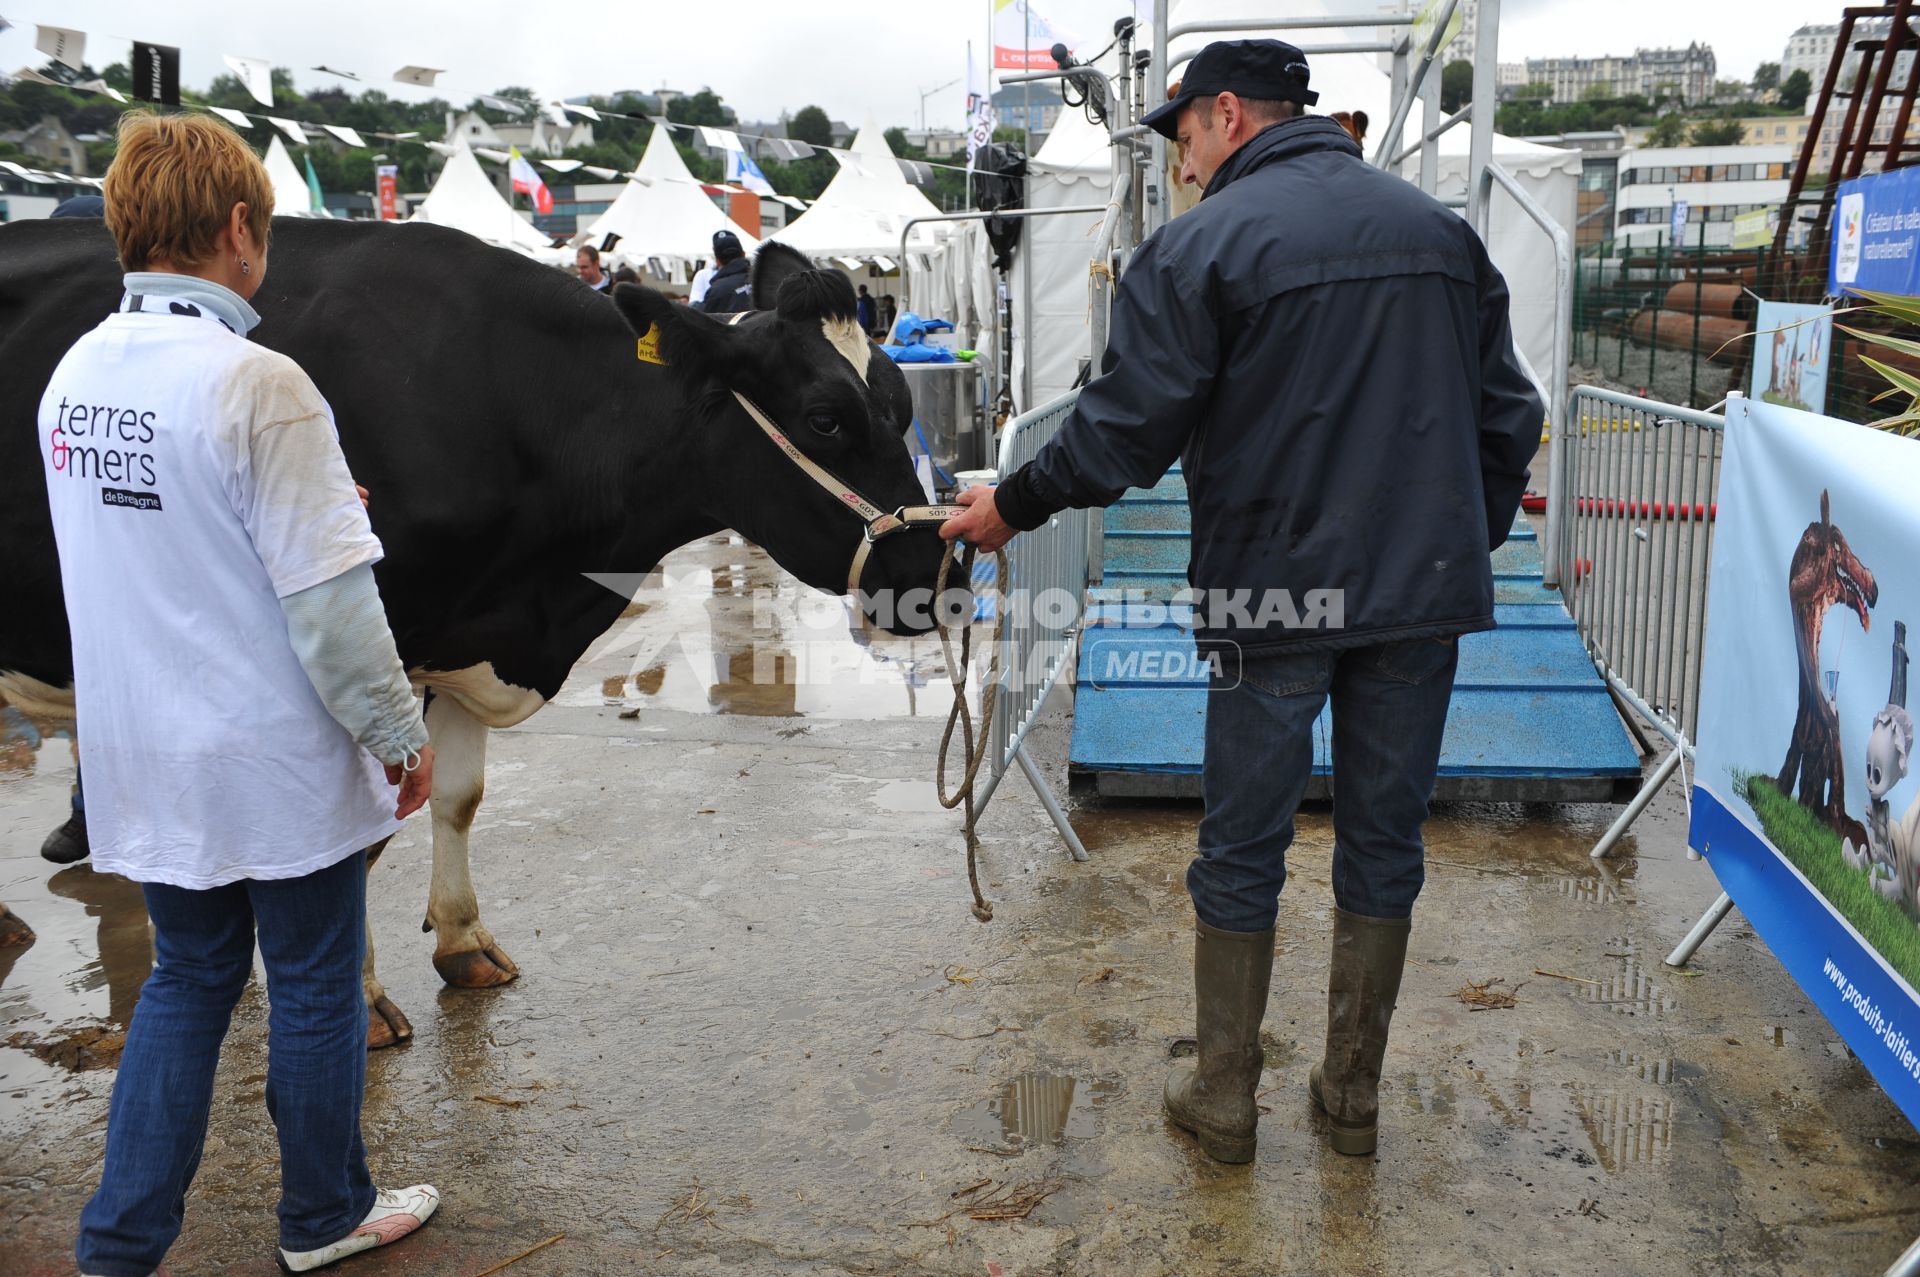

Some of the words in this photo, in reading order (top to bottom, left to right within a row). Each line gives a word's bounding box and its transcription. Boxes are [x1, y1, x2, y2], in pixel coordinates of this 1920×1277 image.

[1866, 211, 1893, 233] Créateur
[1894, 208, 1903, 231] de
[58, 396, 156, 443] terres
[859, 503, 875, 517] GDS
